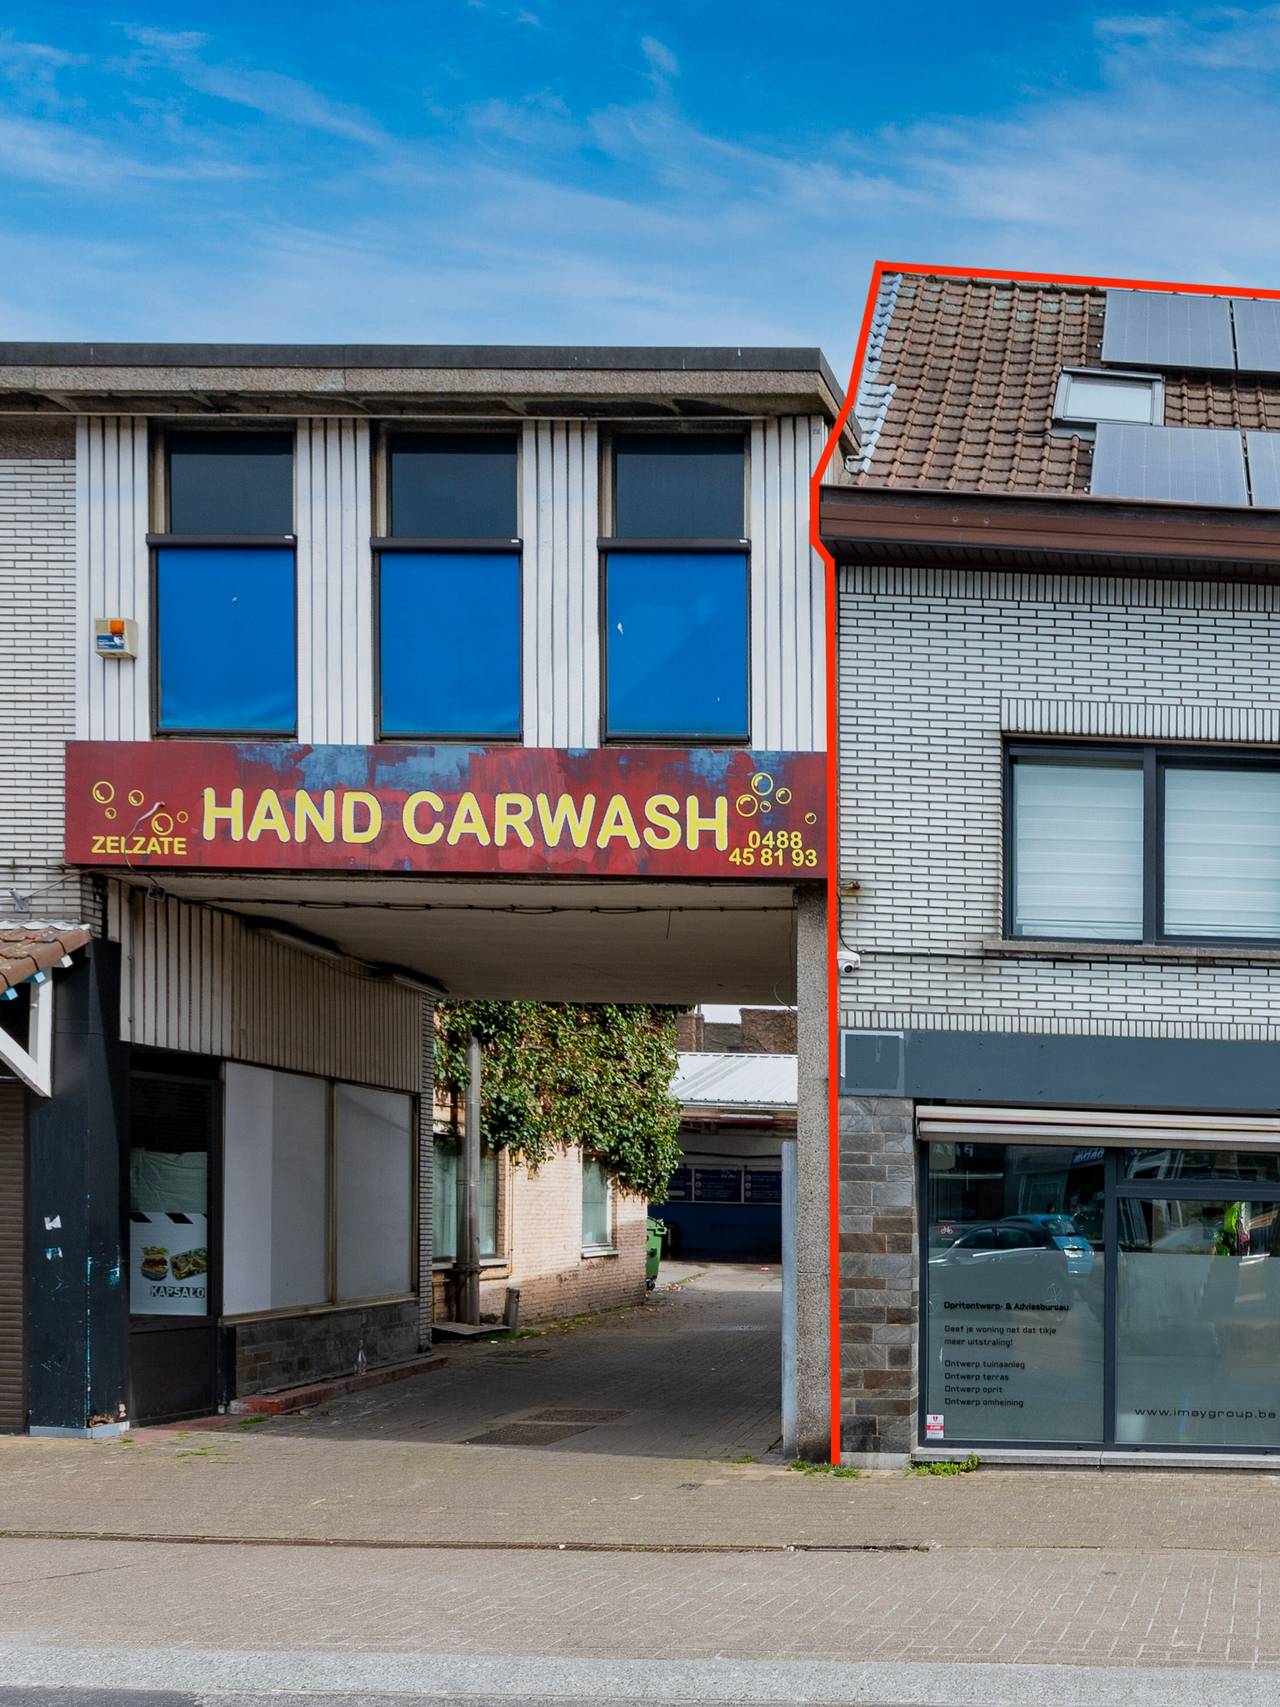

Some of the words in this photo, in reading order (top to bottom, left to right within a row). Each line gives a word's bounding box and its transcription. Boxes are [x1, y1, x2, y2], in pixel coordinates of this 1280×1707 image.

[202, 787, 382, 844] HAND
[402, 790, 728, 851] CARWASH
[748, 830, 802, 849] 0488
[91, 836, 187, 855] ZELZATE
[728, 848, 755, 866] 45
[760, 848, 784, 867] 81
[791, 849, 818, 867] 93
[944, 1325, 964, 1333] Geef
[966, 1326, 974, 1334] je
[976, 1326, 1004, 1335] woning
[1039, 1327, 1057, 1336] tikje
[944, 1338, 965, 1346] meer
[967, 1337, 1013, 1347] uitstraling!
[944, 1359, 981, 1369] Ontwerp
[983, 1361, 1025, 1370] tuinaanleg
[944, 1372, 981, 1382] Ontwerp
[944, 1385, 981, 1394] Ontwerp
[982, 1386, 1003, 1394] oprit
[944, 1398, 981, 1407] Ontwerp
[982, 1399, 1024, 1408] omheining
[1134, 1407, 1277, 1420] www.imaygroup.be
